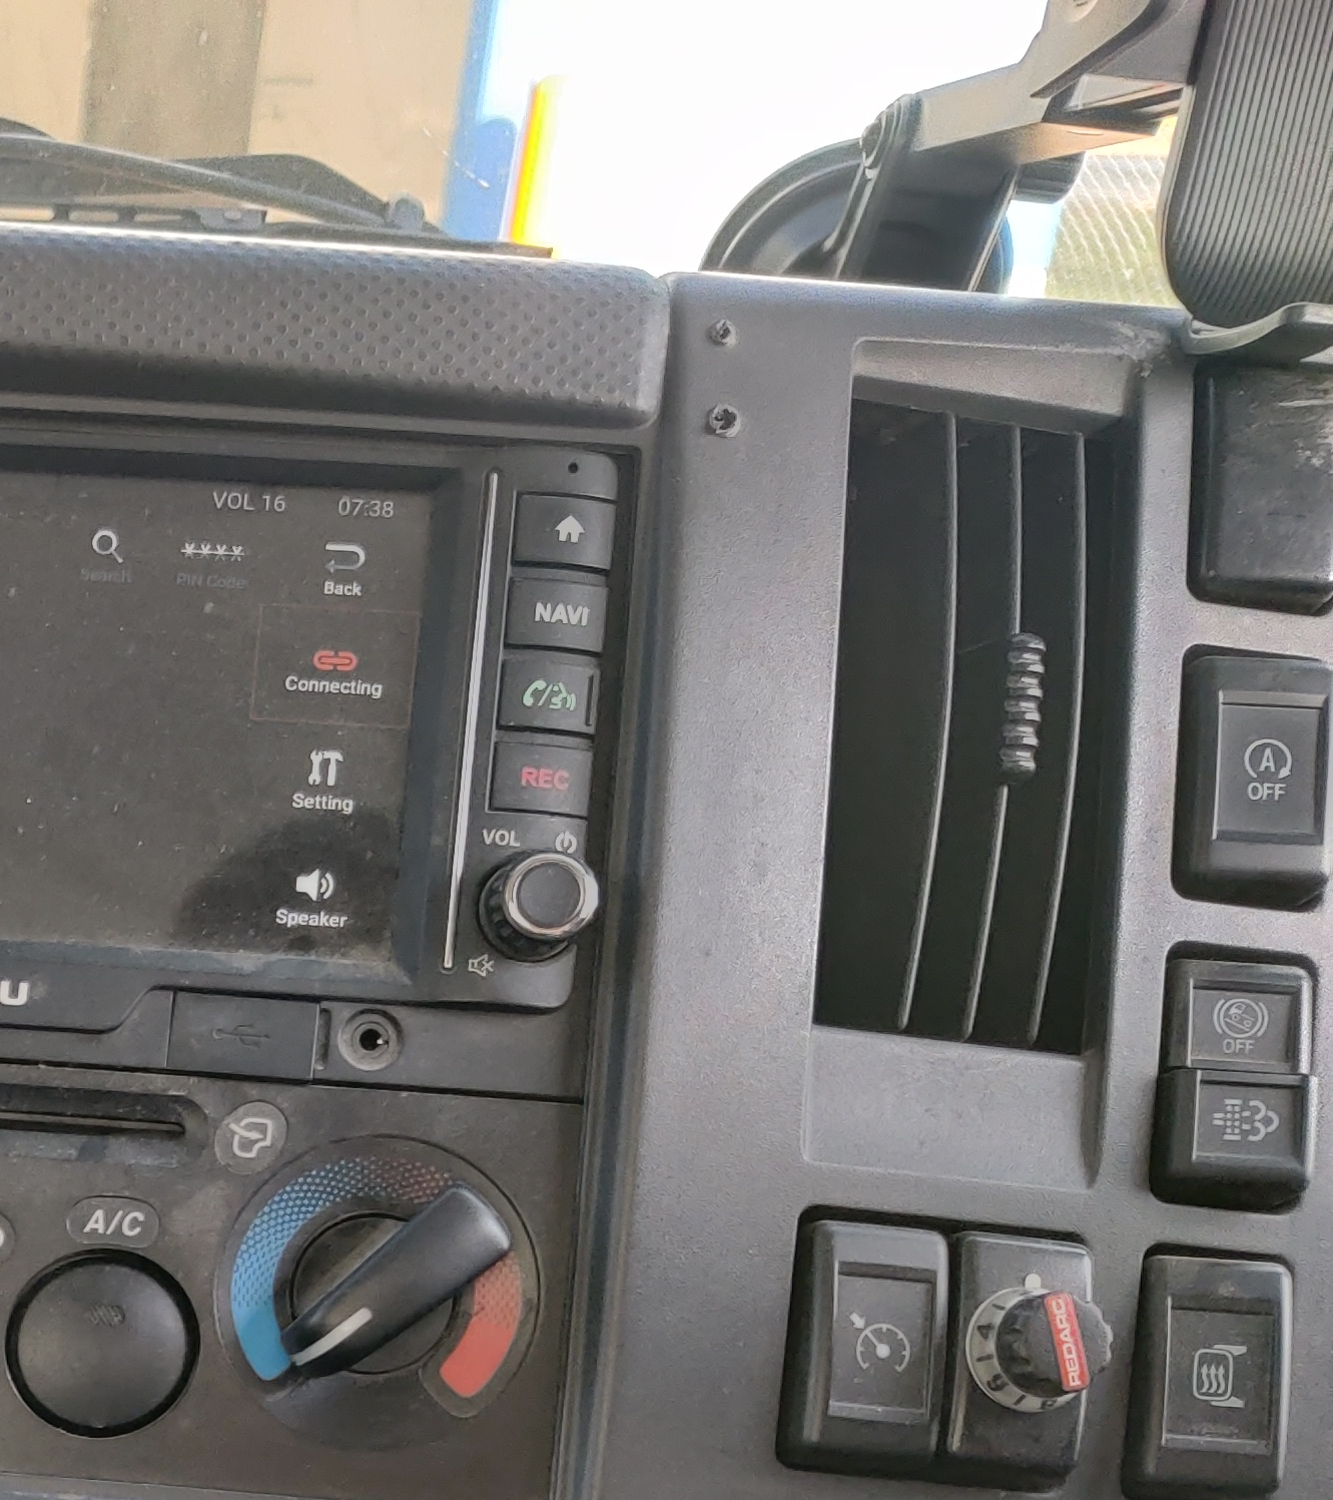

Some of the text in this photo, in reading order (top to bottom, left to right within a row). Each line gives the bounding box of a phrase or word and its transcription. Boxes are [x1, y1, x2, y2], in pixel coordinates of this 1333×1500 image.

[212, 490, 285, 512] VOL 16
[337, 495, 395, 518] 07:38
[323, 580, 362, 597] Back
[534, 602, 590, 626] NAVI
[285, 675, 383, 699] Connecting
[520, 766, 571, 791] REC
[1247, 782, 1287, 801] OFF
[292, 793, 354, 815] Setting
[483, 829, 521, 847] VOL
[275, 908, 348, 928] Speaker
[1223, 1039, 1255, 1055] OFF
[82, 1208, 146, 1237] A/C
[1051, 1298, 1082, 1387] REDARC
